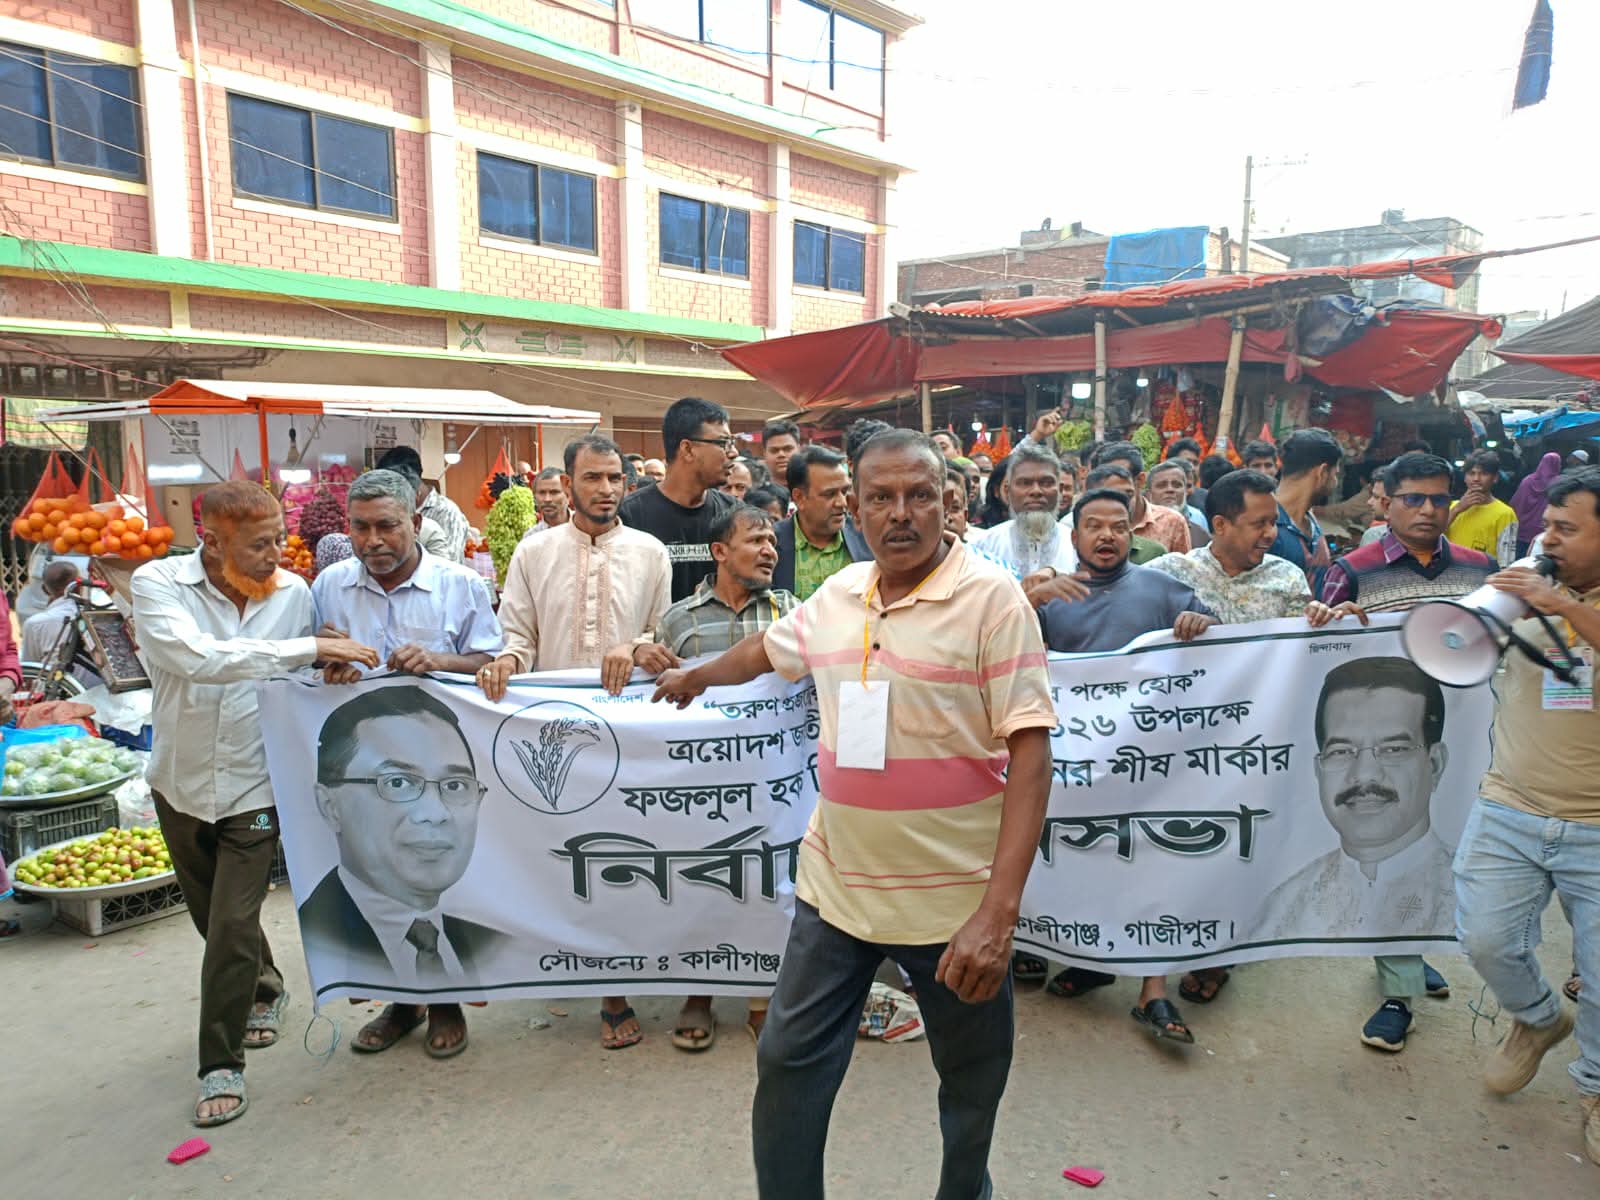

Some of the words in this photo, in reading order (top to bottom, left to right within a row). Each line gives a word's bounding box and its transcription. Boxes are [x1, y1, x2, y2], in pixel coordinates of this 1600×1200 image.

[1070, 681, 1129, 702] পক্ষে
[1050, 715, 1117, 741] ০২৬
[1129, 700, 1254, 734] উপলক্ষে
[666, 729, 786, 765] ত্রয়োদশ
[1107, 744, 1176, 783] শীষ
[1184, 734, 1295, 776] মার্কার
[619, 782, 757, 822] ফজলুল
[766, 770, 804, 808] হক
[539, 950, 648, 972] সৌজন্যে
